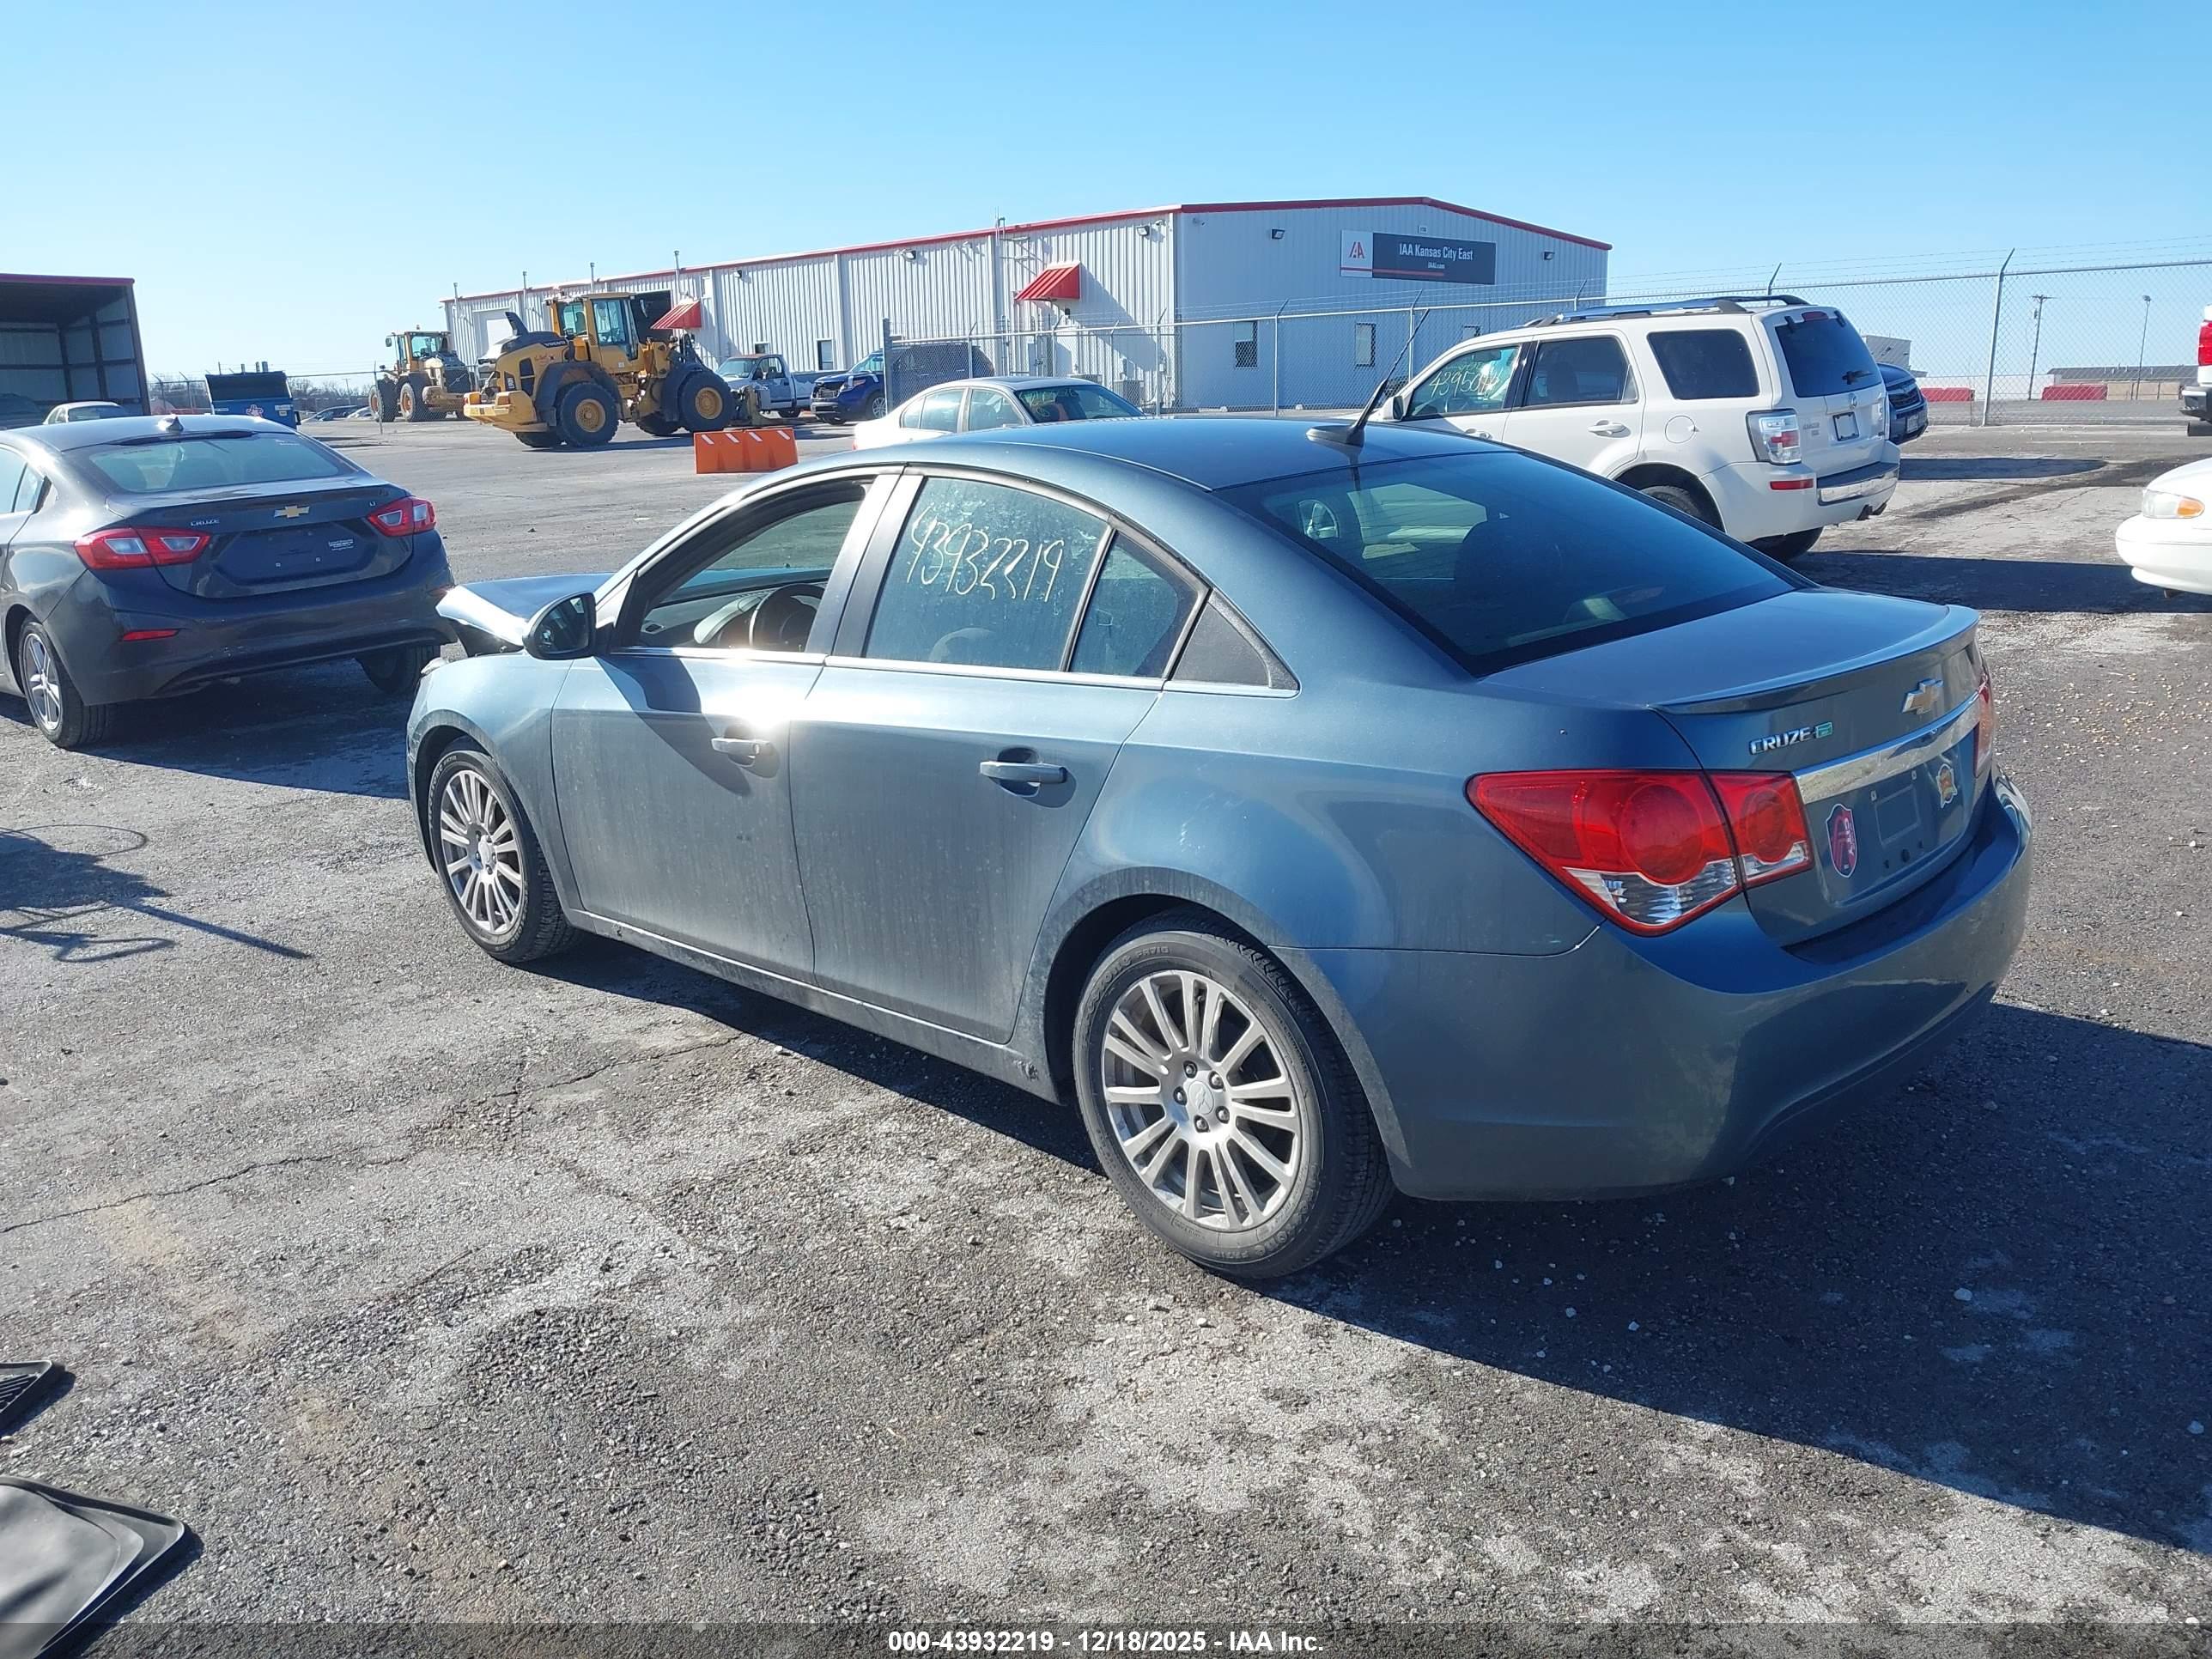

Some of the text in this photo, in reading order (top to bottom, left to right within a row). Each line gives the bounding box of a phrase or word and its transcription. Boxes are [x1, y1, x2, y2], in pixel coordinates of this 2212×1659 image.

[1399, 242, 1474, 262] IAA Kansas City East
[906, 502, 1064, 603] 43932219
[1749, 726, 1812, 755] CRUZE
